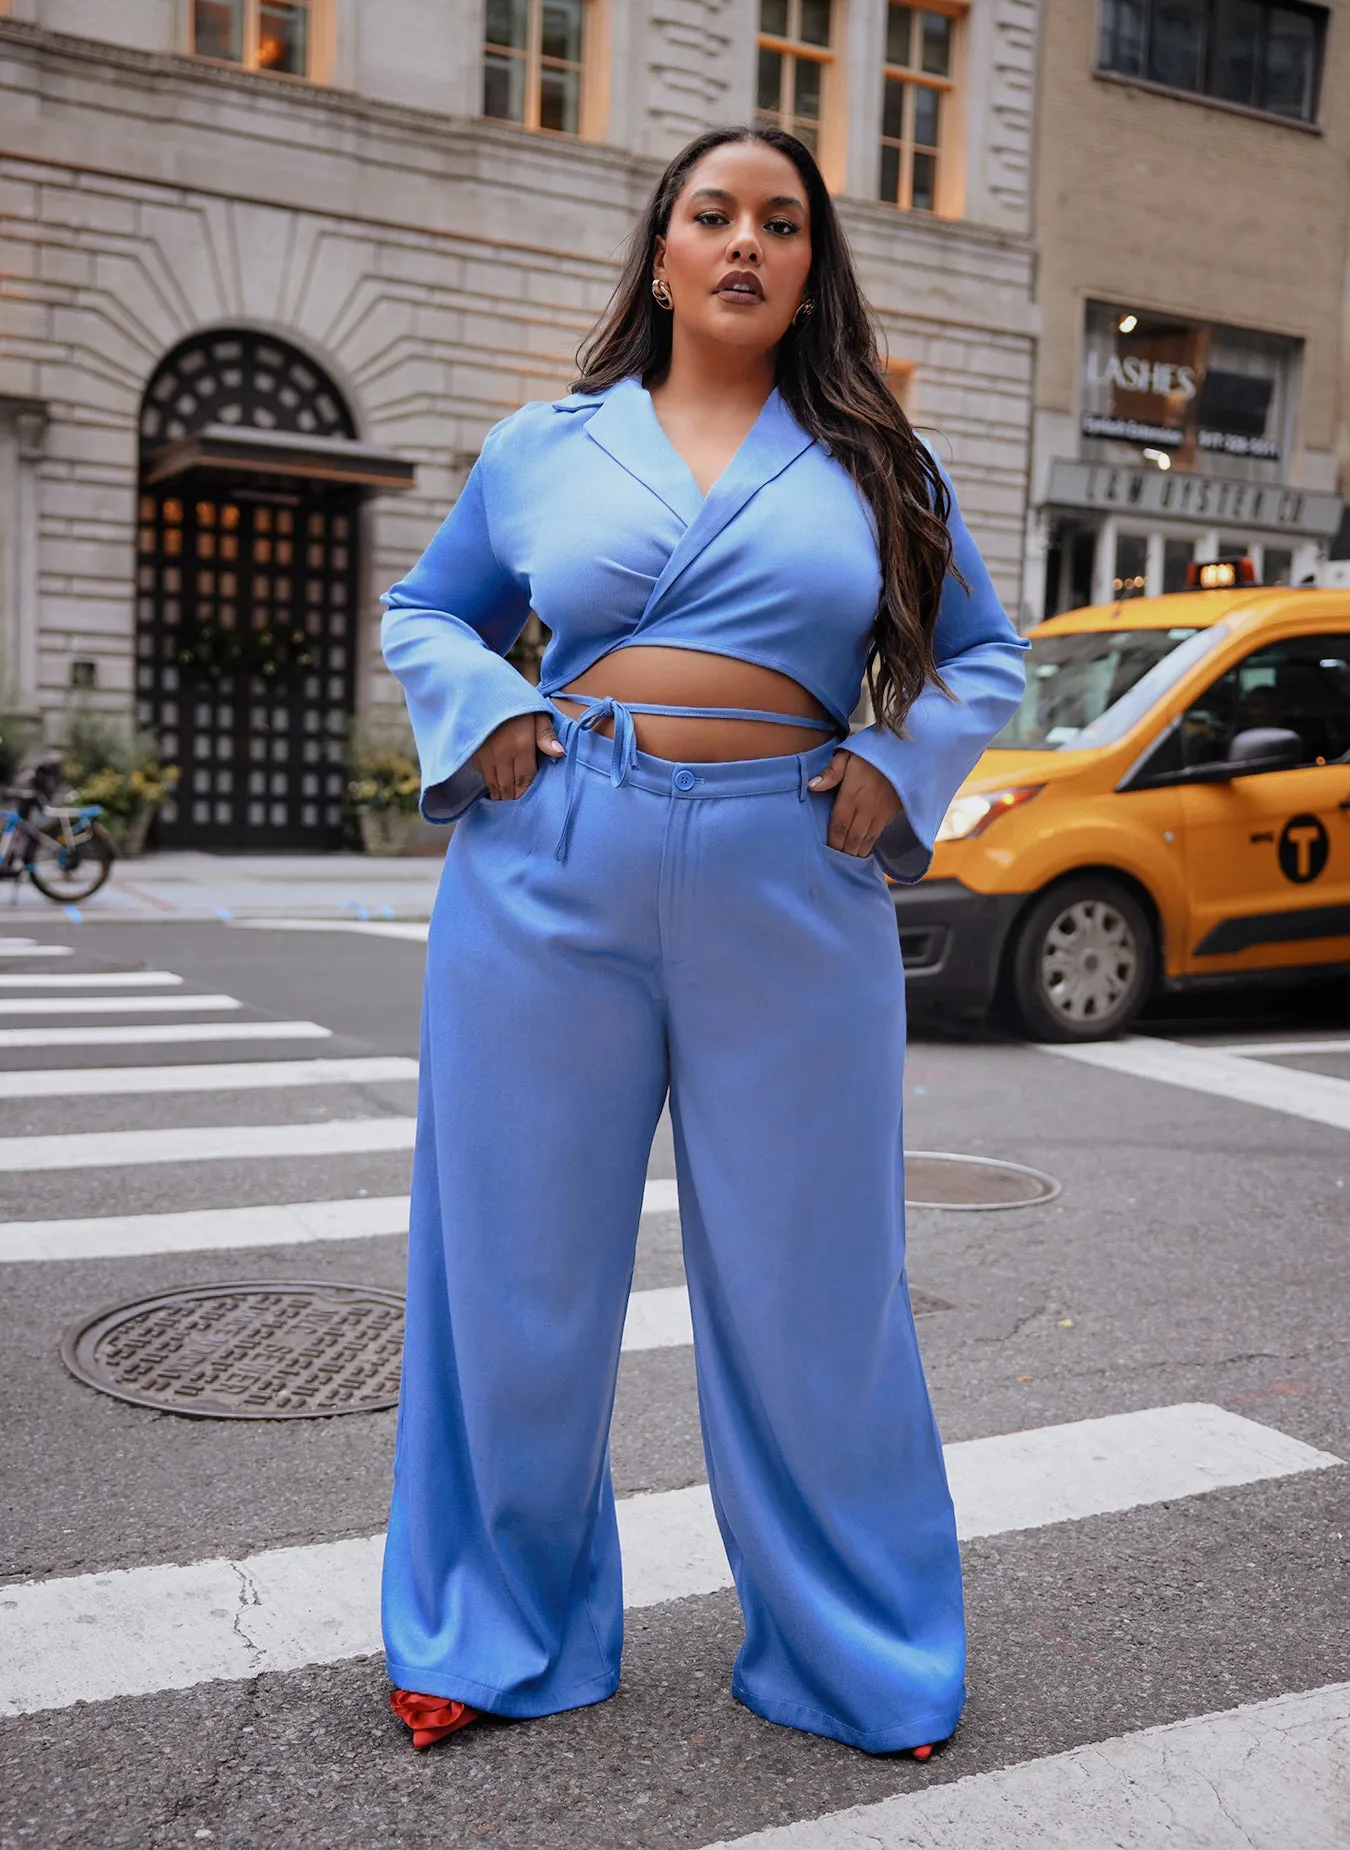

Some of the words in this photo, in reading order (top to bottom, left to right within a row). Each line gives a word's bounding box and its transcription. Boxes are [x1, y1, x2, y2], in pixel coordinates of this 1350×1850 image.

[1086, 352, 1197, 400] LASHES
[1287, 825, 1319, 877] T
[211, 1344, 294, 1395] SEWER
